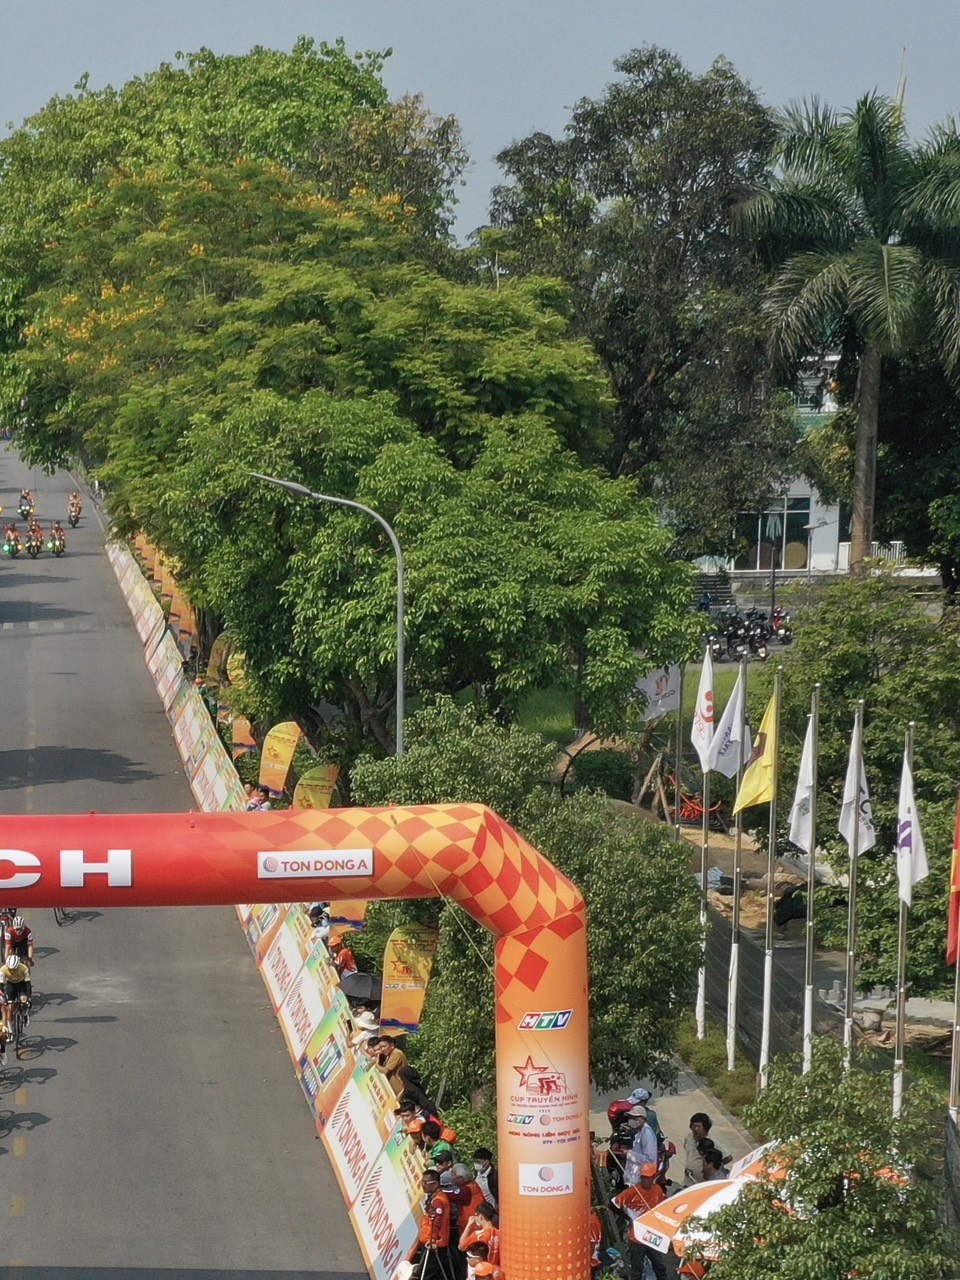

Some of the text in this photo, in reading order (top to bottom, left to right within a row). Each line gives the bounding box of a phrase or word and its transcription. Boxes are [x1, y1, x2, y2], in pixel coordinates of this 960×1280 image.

[281, 859, 368, 872] TON DONG A
[519, 1012, 570, 1029] HTV
[507, 1113, 534, 1125] HTV
[336, 1111, 369, 1190] TON DONG A
[540, 1185, 563, 1193] DONG
[365, 1188, 402, 1280] TON DONG A
[643, 1231, 662, 1247] HTV
